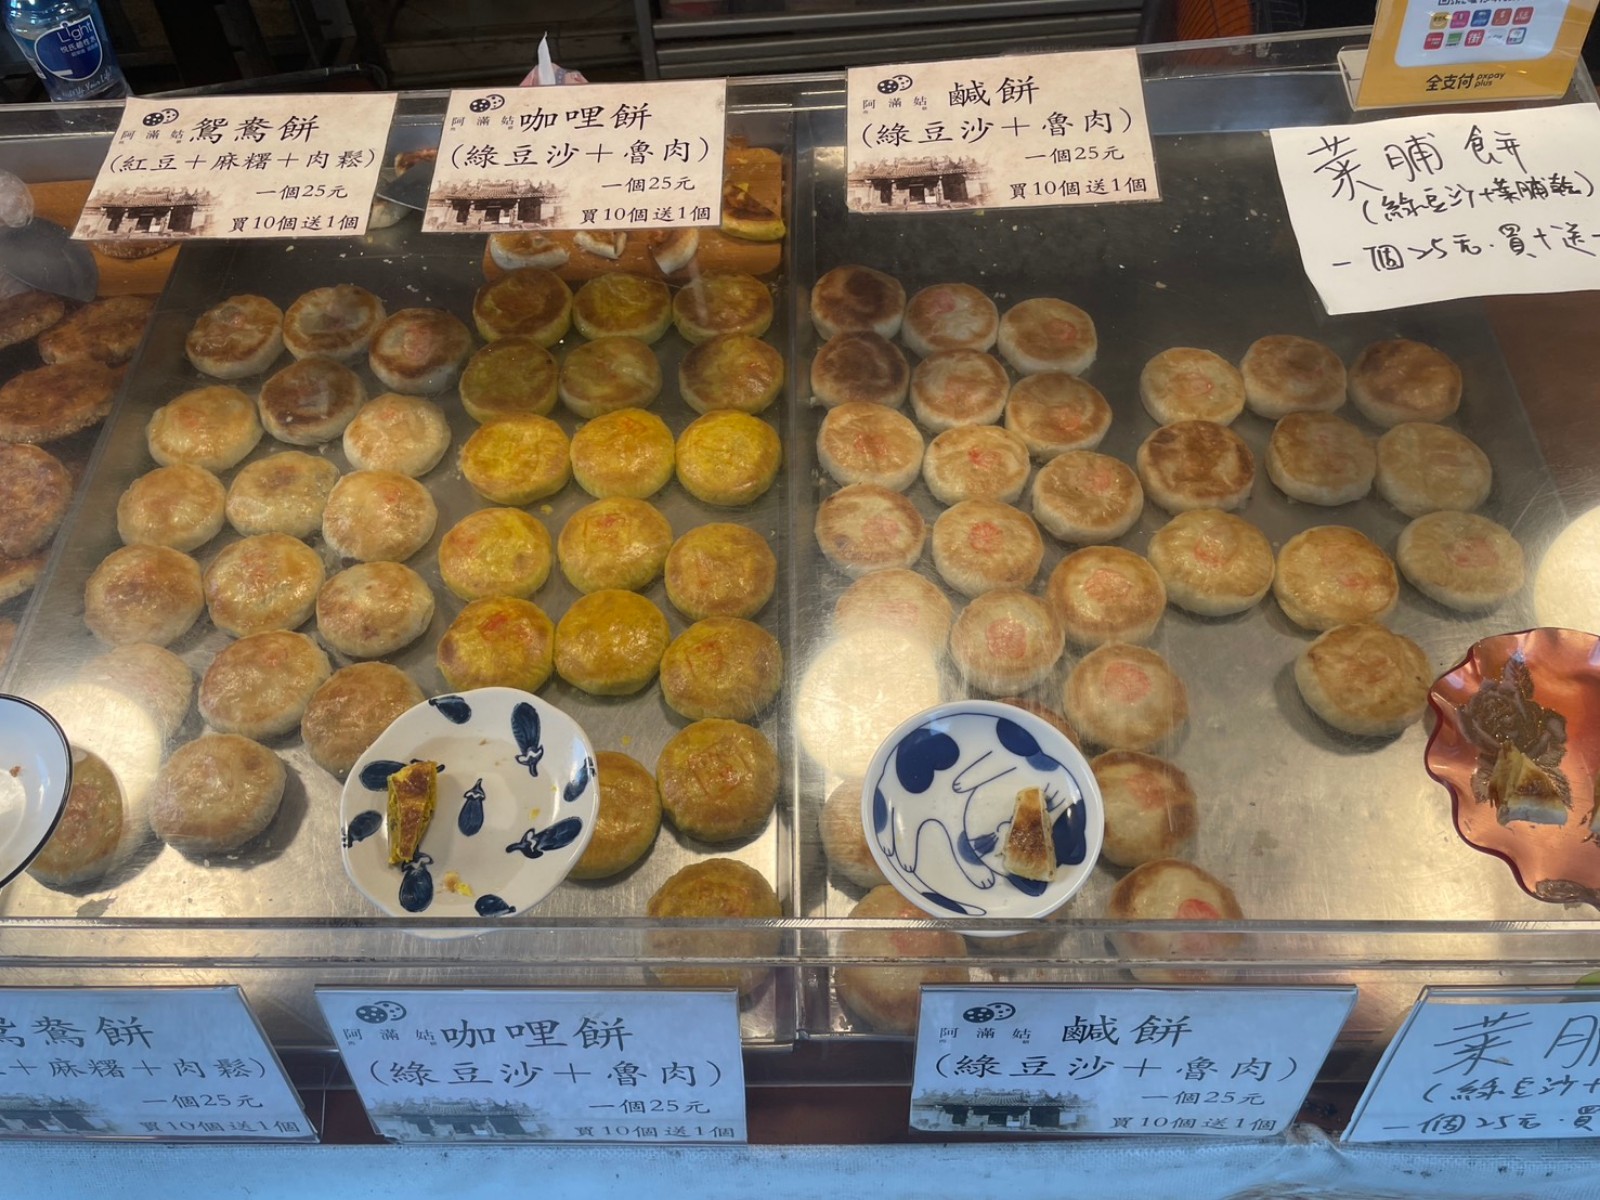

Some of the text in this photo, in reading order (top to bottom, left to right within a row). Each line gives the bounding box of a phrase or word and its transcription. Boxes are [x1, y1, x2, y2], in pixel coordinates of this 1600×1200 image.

[948, 75, 1041, 107] 鹹餅
[1426, 73, 1475, 91] 全支付
[1474, 79, 1493, 88] plus
[520, 103, 653, 132] 咖哩餅
[189, 115, 320, 144] 鴛鴦餅
[1024, 145, 1125, 163] 一個25元
[1307, 125, 1528, 201] 菜脯餅
[255, 183, 349, 200] 一個25元
[601, 176, 696, 192] 一個25元
[1009, 177, 1147, 200] 買10個送1個
[231, 215, 359, 233] 買10個送1個
[580, 206, 711, 224] 買10個送1個
[441, 1016, 633, 1053] 咖哩餅
[1061, 1014, 1193, 1048] 鹹餅
[142, 1093, 264, 1109] 一個25元
[588, 1098, 711, 1115] 一個25元
[1140, 1090, 1266, 1107] 一個25元
[574, 1124, 735, 1139] 買10個送1個
[1108, 1115, 1278, 1133] 買10個送1個
